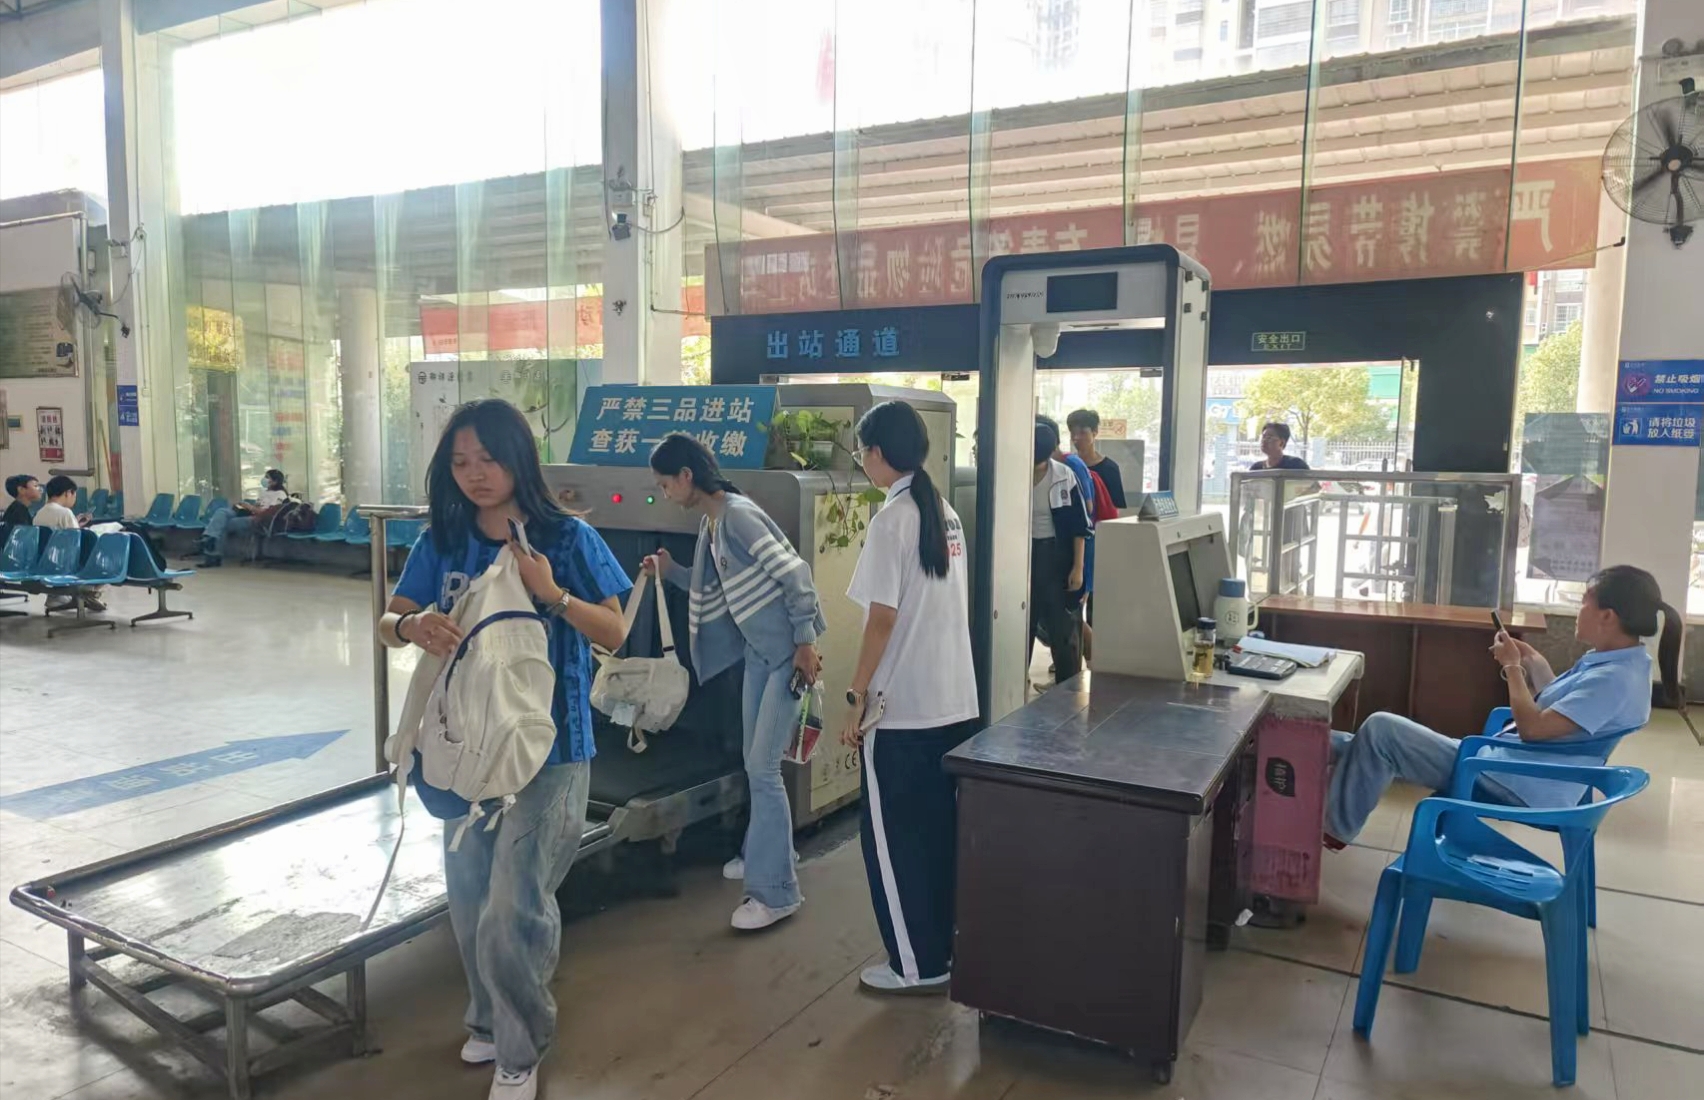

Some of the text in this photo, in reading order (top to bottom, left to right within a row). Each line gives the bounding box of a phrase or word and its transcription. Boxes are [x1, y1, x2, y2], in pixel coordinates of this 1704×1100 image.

[766, 326, 900, 359] 出站通道
[1257, 333, 1300, 344] 安全出口
[1654, 373, 1701, 384] 禁止吸烟
[595, 396, 755, 424] 严禁三品进站
[1648, 416, 1697, 429] 请将垃圾
[588, 428, 749, 458] 查获一收缴
